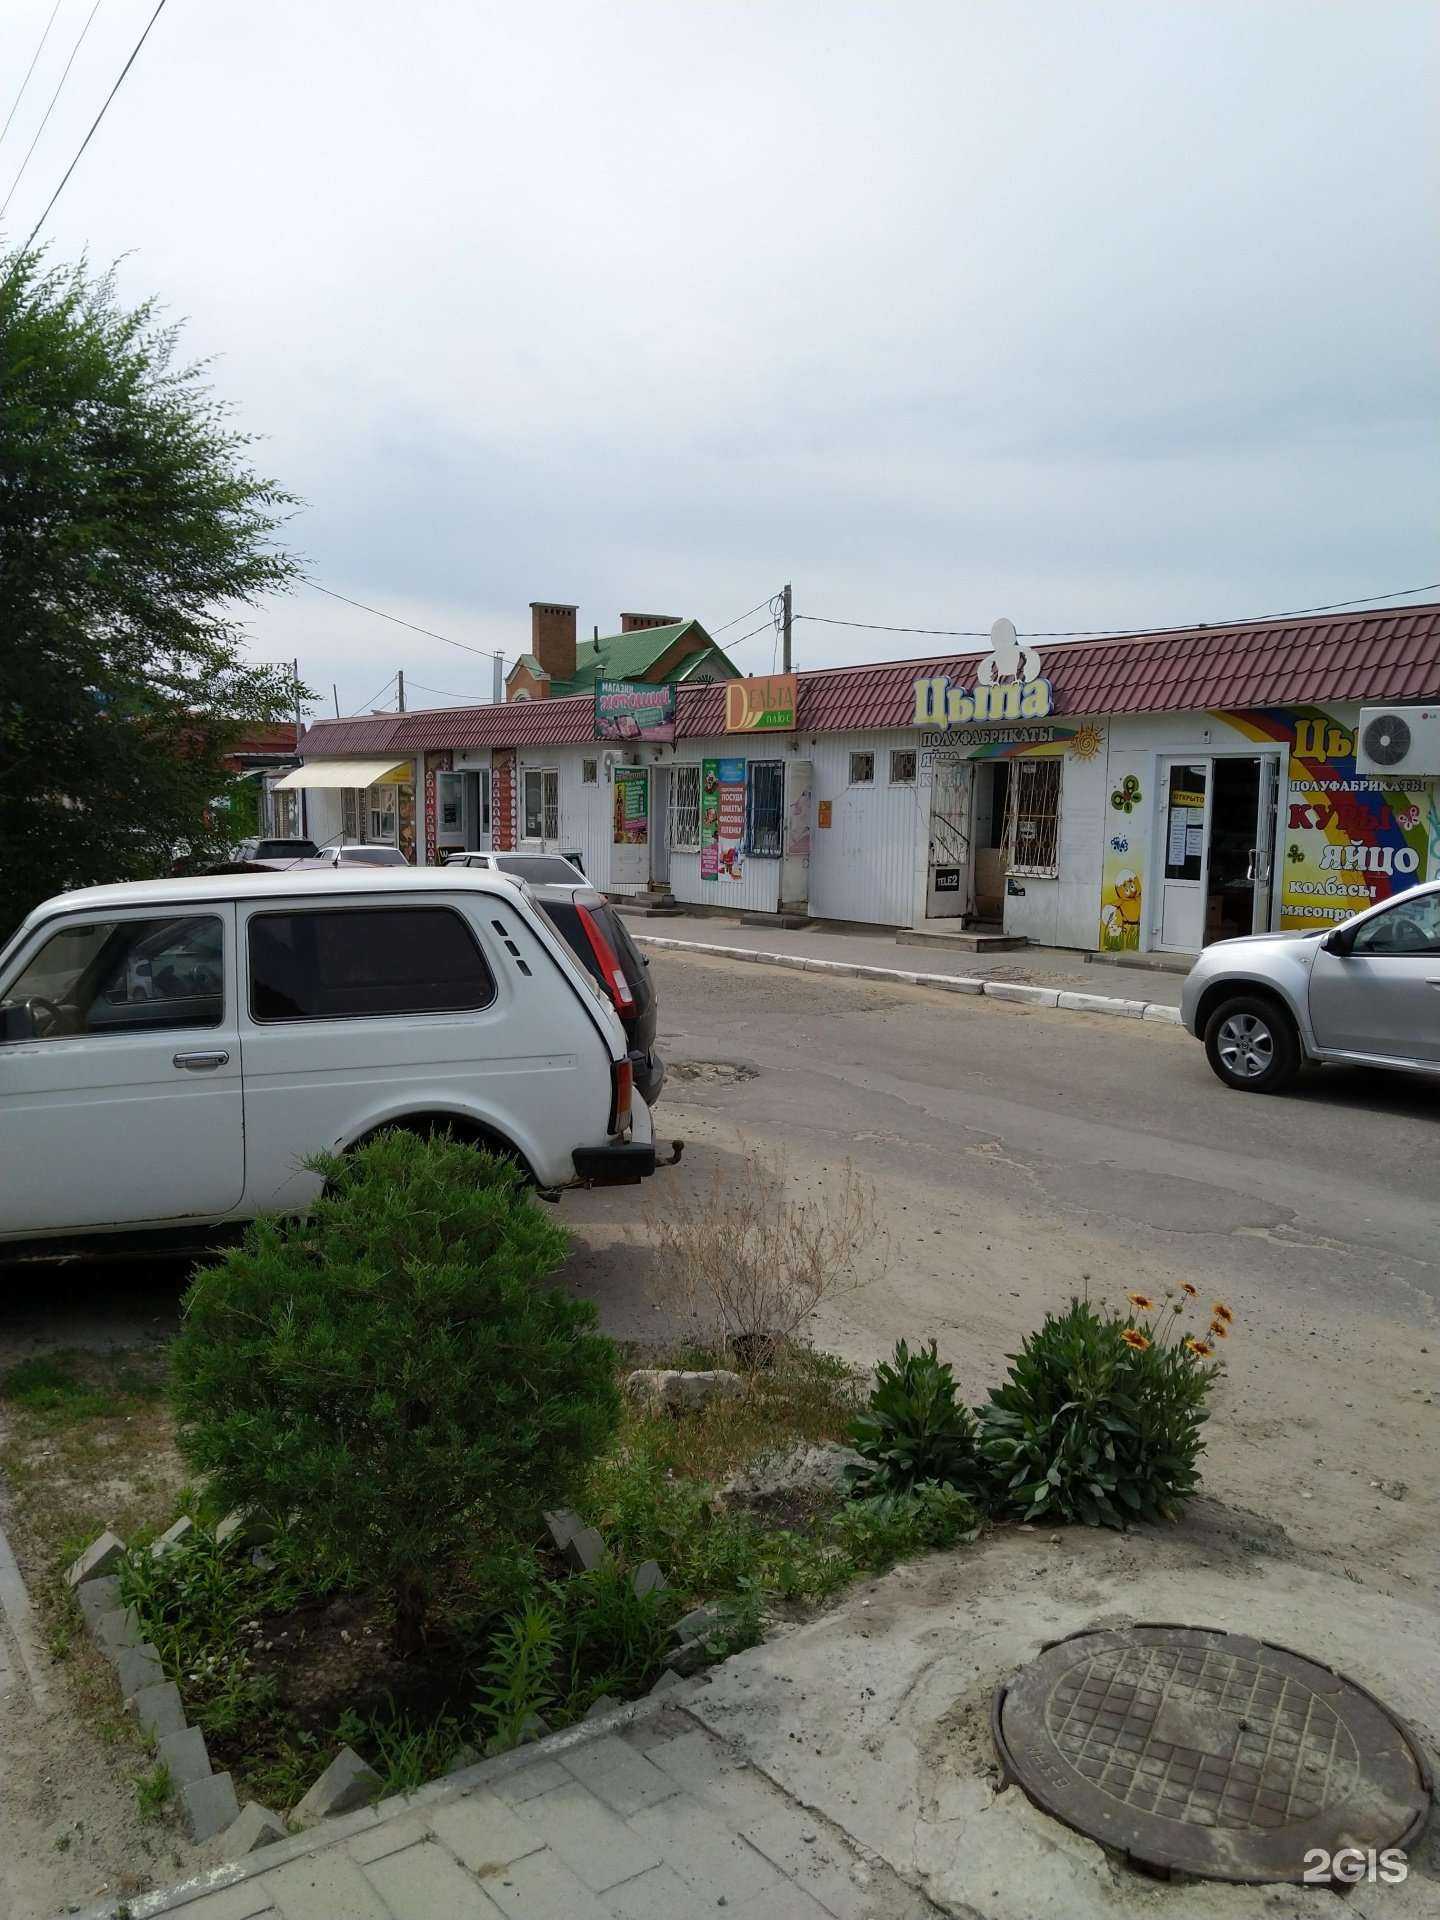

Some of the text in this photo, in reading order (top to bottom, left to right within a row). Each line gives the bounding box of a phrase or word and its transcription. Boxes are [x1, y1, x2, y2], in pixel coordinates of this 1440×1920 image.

[602, 682, 634, 694] МАГАЗИН
[913, 677, 1053, 729] Цыпа
[921, 727, 1055, 747] ПОЛУФАБРИКАТЫ
[1291, 780, 1426, 792] ПОЛУФАБРИКАТЫ
[1174, 794, 1205, 803] ОТКРЫТО
[1288, 804, 1391, 829] КУРЫ
[1319, 840, 1419, 875] ЯЙЦО
[937, 875, 958, 887] TELE2
[1280, 904, 1361, 921] мясопро
